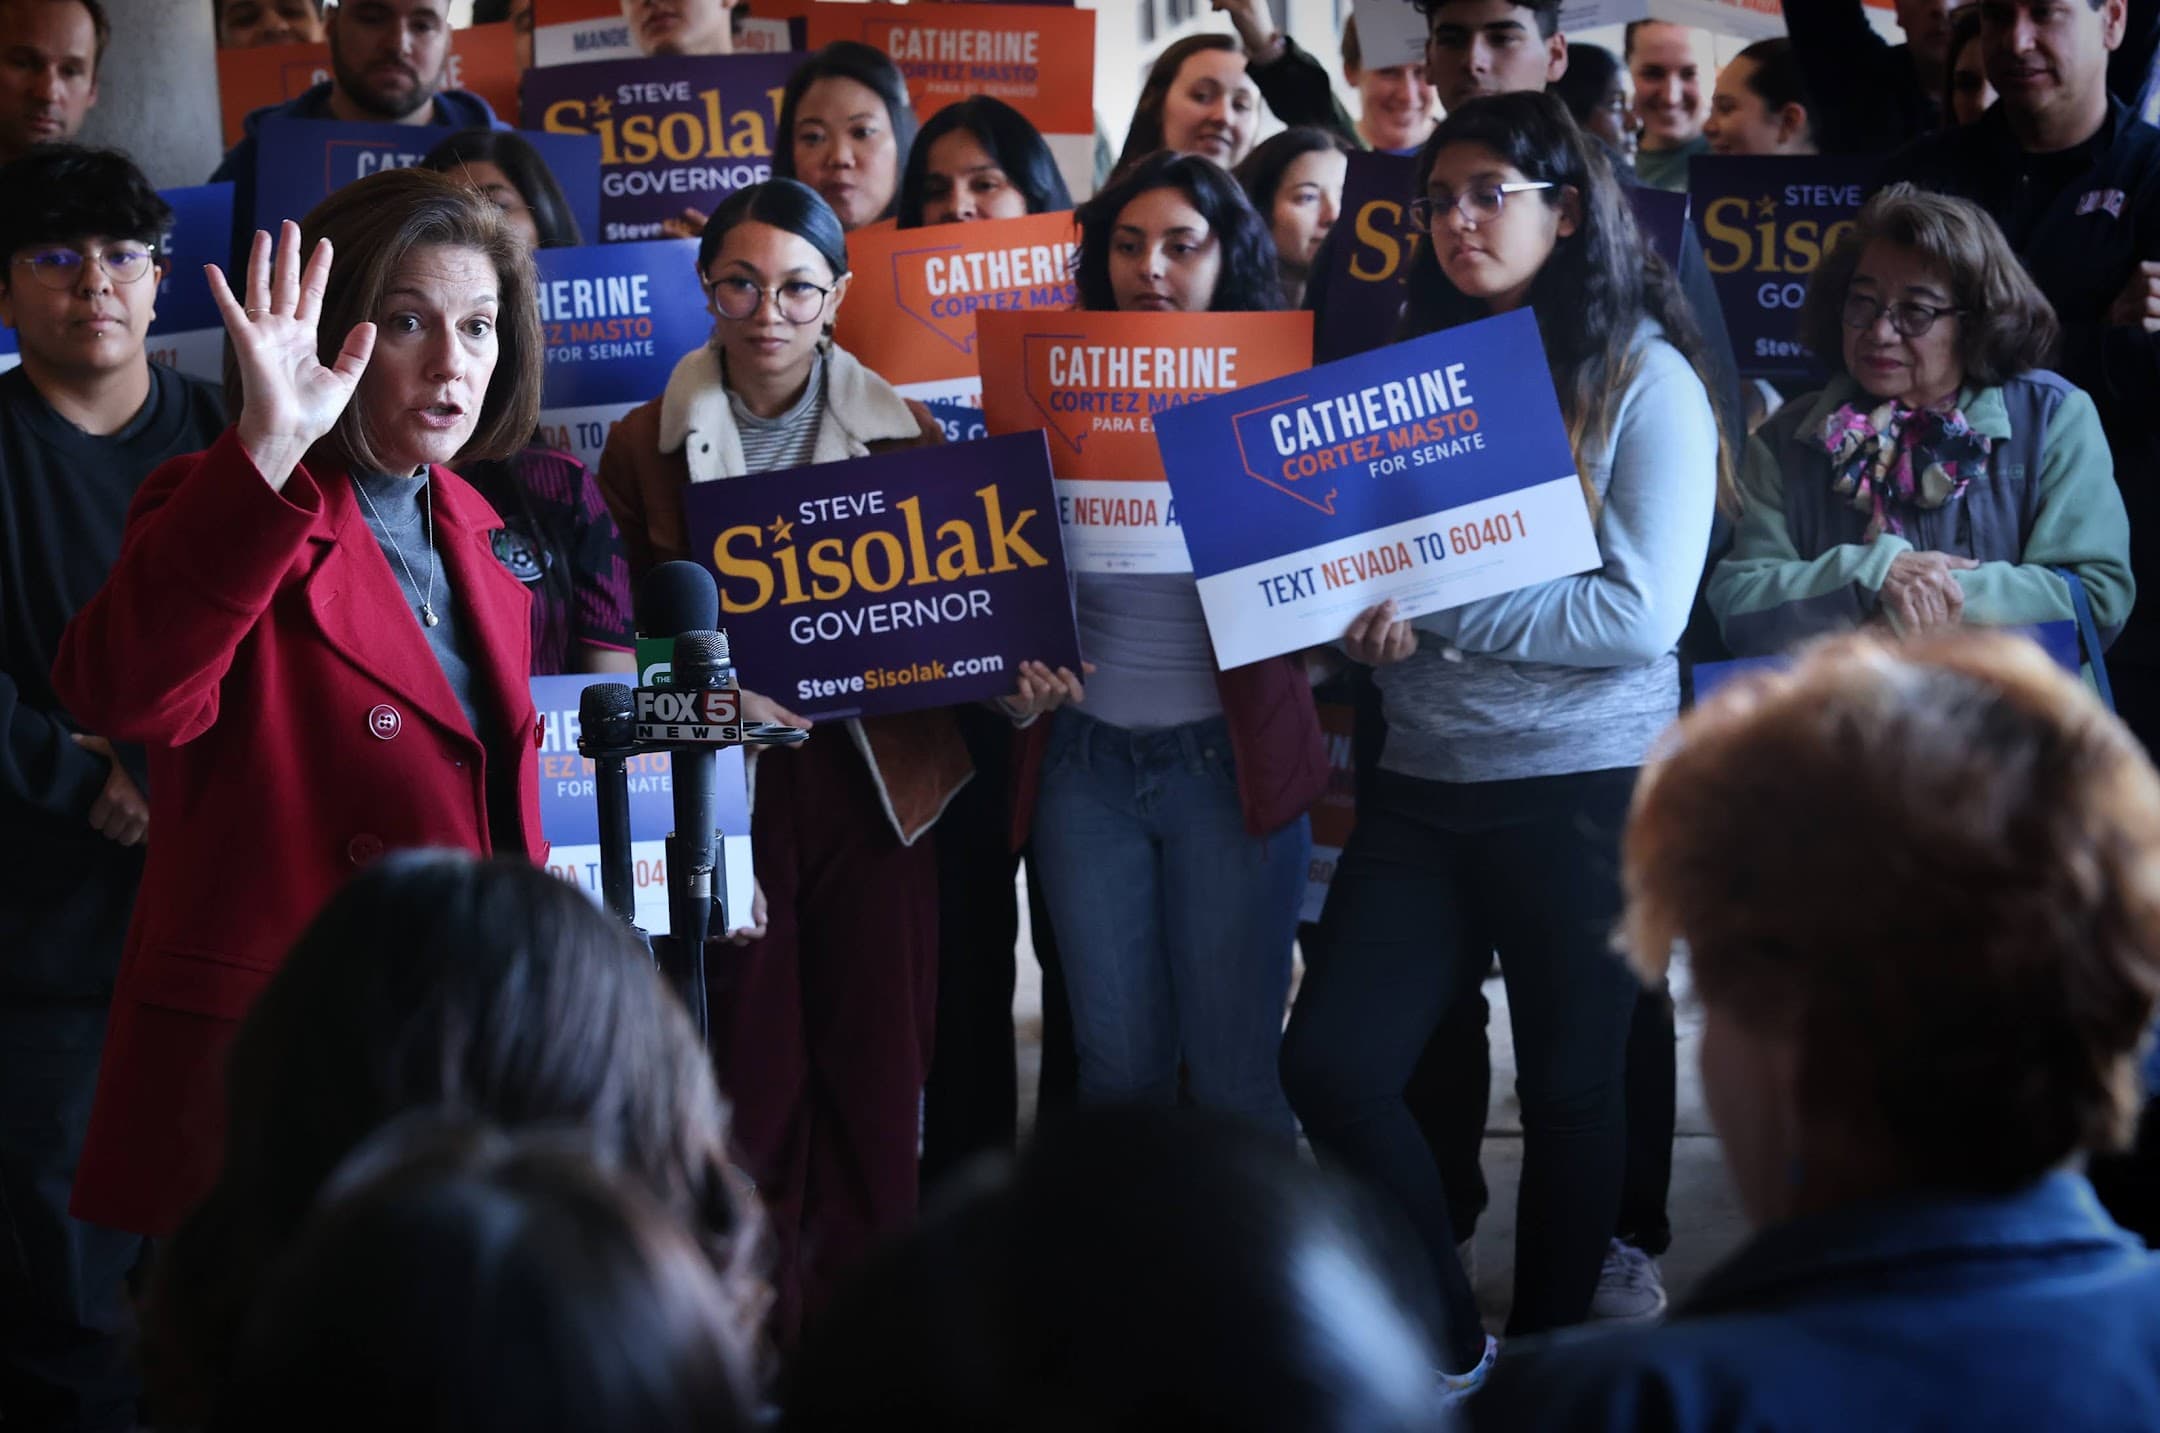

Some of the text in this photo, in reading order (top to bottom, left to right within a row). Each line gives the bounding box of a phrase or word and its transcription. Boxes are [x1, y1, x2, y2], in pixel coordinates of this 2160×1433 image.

[888, 27, 1040, 65] CATHERINE
[904, 62, 965, 80] ORTEZ
[616, 81, 691, 104] STEVE
[543, 87, 786, 165] Sisola
[1784, 184, 1864, 207] STEVE
[537, 274, 651, 321] HERINE
[571, 317, 654, 345] MASTO
[548, 341, 655, 364] FOR SENATE
[1049, 345, 1238, 389] CATHERINE
[1050, 391, 1141, 413] CORTEZ
[1269, 362, 1474, 457] CATHERINE
[576, 422, 603, 449] TO
[1092, 416, 1135, 433] PARA
[1282, 408, 1479, 481] CORTEZ MASTO
[1368, 432, 1487, 479] FOR SENATE
[799, 490, 887, 525] STEVE
[1074, 498, 1158, 527] NEVADA
[712, 483, 1049, 614] Sisolak
[1258, 567, 1317, 607] TEXT
[1321, 541, 1414, 591] NEVADA
[1413, 532, 1447, 564] TO
[1449, 509, 1527, 556] 60401
[789, 589, 993, 645] GOVERNOR
[655, 675, 673, 684] THE
[797, 654, 1004, 700] SteveSisolak.com
[637, 692, 737, 723] FOX 5
[639, 725, 737, 739] NEWS
[557, 775, 671, 798] FOR NATE
